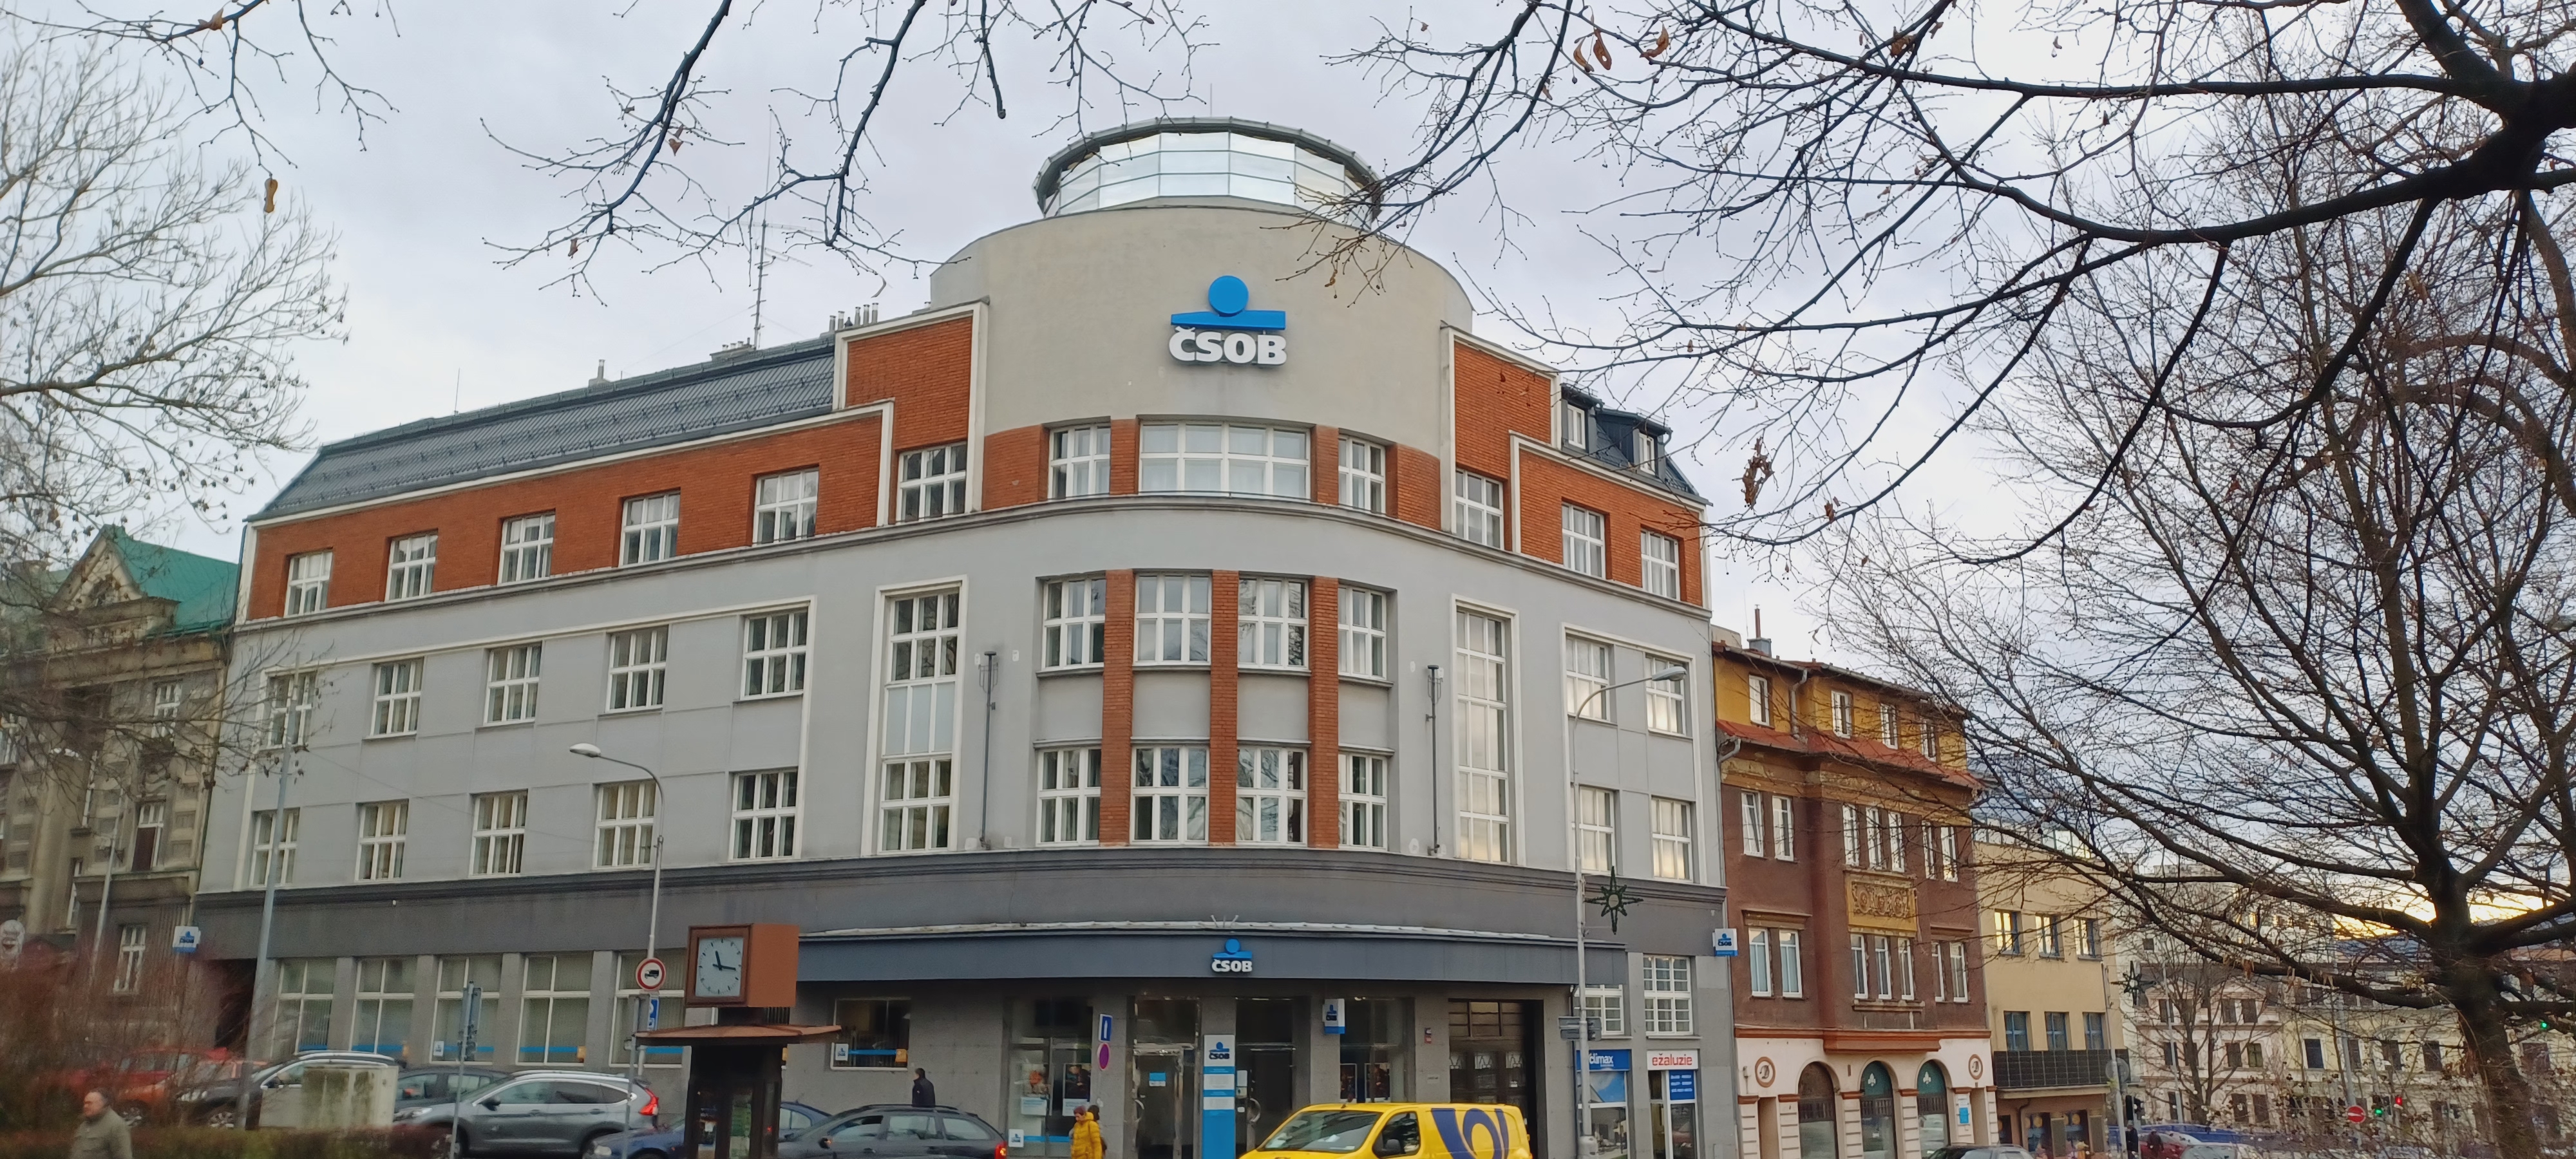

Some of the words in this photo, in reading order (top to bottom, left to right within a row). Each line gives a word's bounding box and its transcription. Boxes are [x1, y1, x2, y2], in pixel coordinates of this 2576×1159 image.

[1169, 326, 1287, 365] ČSOB
[1211, 959, 1253, 972] ČSOB
[1652, 1053, 1692, 1066] ežaluzie
